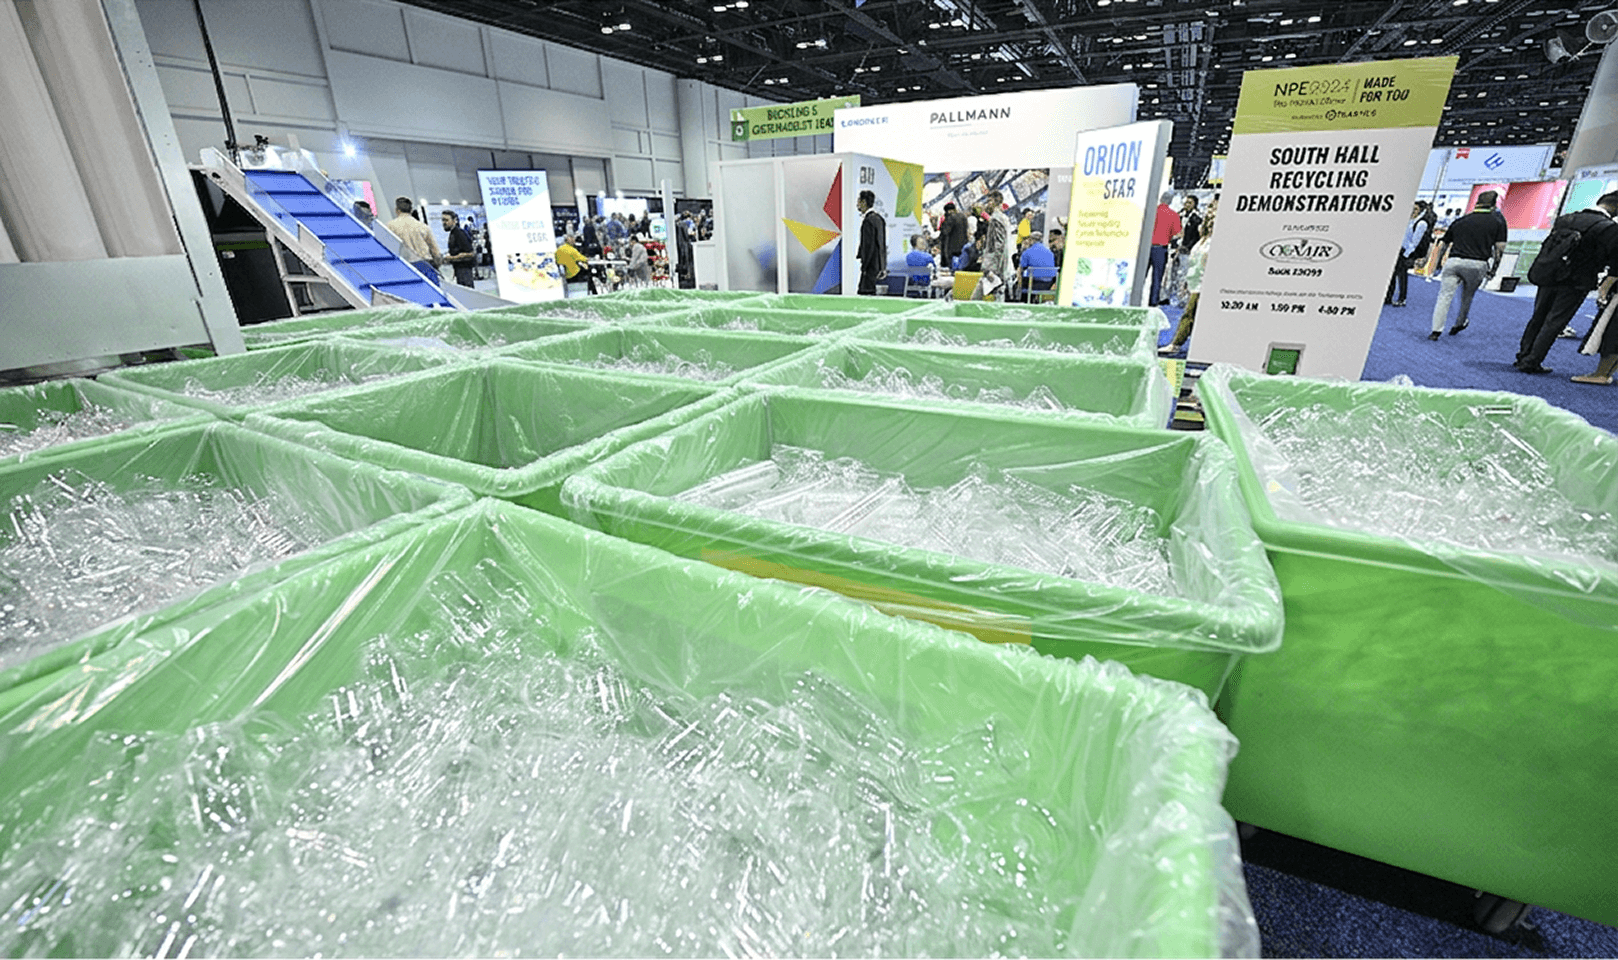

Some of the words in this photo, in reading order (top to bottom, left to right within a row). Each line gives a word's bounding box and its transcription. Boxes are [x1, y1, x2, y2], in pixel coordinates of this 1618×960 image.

[1359, 91, 1383, 103] FOR
[929, 106, 1011, 124] PALLMANN
[1083, 140, 1142, 176] ORION
[1269, 147, 1330, 165] SOUTH
[1334, 145, 1380, 164] HALL
[1269, 170, 1369, 189] RECYCLING
[1236, 194, 1394, 212] DEMONSTRATIONS
